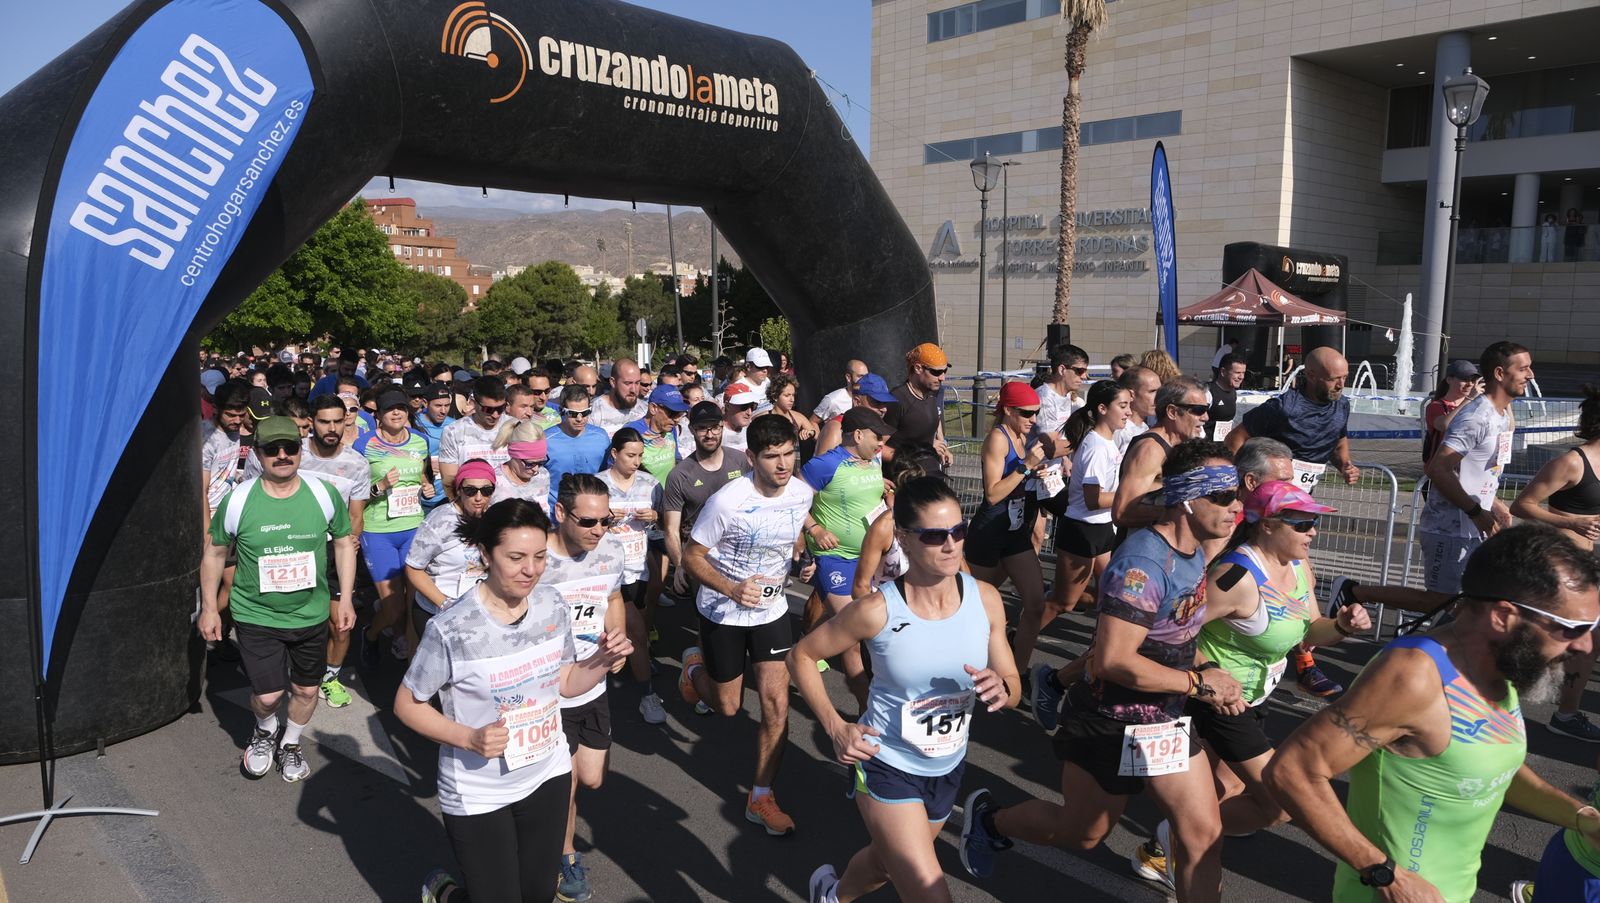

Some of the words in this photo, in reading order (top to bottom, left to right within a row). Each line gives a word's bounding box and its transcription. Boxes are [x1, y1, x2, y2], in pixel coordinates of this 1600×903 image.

[623, 95, 718, 123] cronometraje
[720, 110, 779, 132] deportivo
[181, 99, 304, 287] centrohogarsanchez.es
[1300, 472, 1315, 484] 64
[273, 545, 294, 553] Ejido
[267, 565, 308, 580] 1211
[763, 585, 782, 598] 99
[513, 714, 557, 747] 1064
[920, 710, 966, 736] 157
[1135, 736, 1183, 759] 1192
